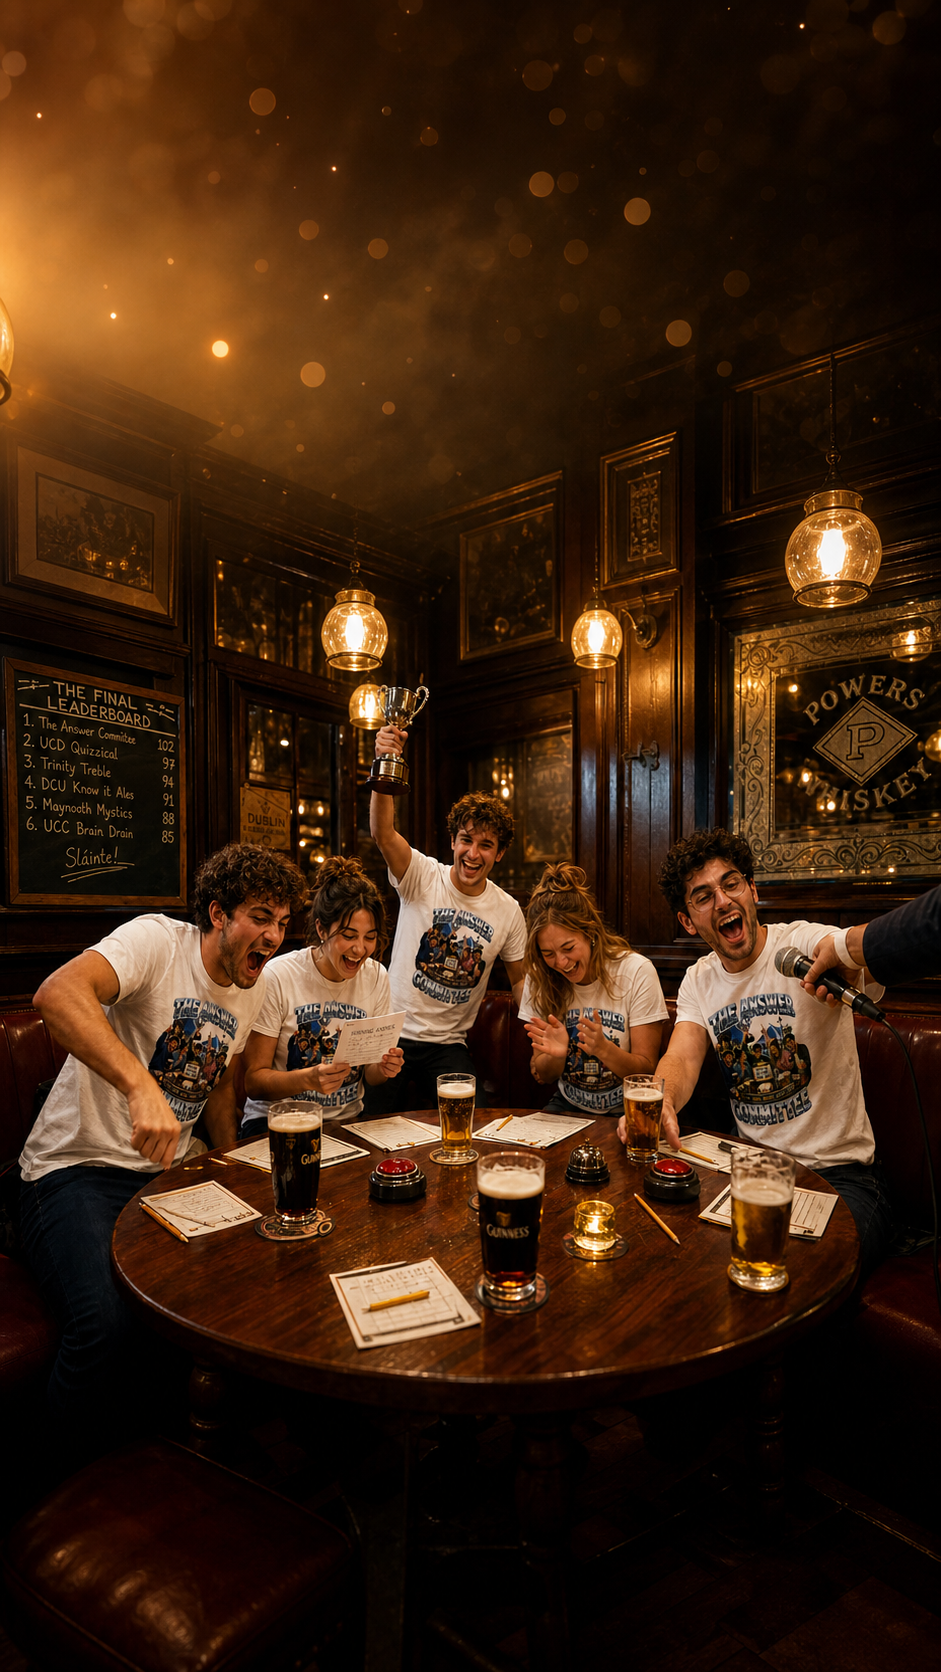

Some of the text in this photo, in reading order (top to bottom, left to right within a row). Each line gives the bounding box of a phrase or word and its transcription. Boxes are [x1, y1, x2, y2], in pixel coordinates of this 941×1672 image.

[53, 681, 137, 710] THE FINAL
[803, 673, 926, 725] POWERS
[47, 696, 151, 728] LEADERBOARD
[23, 713, 34, 727] 1.
[38, 716, 57, 731] The
[60, 720, 95, 737] Answer
[157, 739, 175, 753] 102
[846, 721, 885, 761] P
[23, 733, 175, 770] 2. UCD Quizzical 97
[23, 754, 174, 788] 3. Trinity Treble 94
[797, 757, 932, 812] WHISKEY
[24, 775, 175, 807] 4. DCU Know it Ales 91
[25, 796, 175, 825] 5. Maynooth Mystics 88
[26, 816, 175, 843] 6. UCC Brain Drain 85
[65, 846, 118, 868] Sláinte!
[294, 1002, 321, 1024] THE
[707, 992, 796, 1037] THE ANSWER
[486, 1223, 530, 1239] GUINNESS
